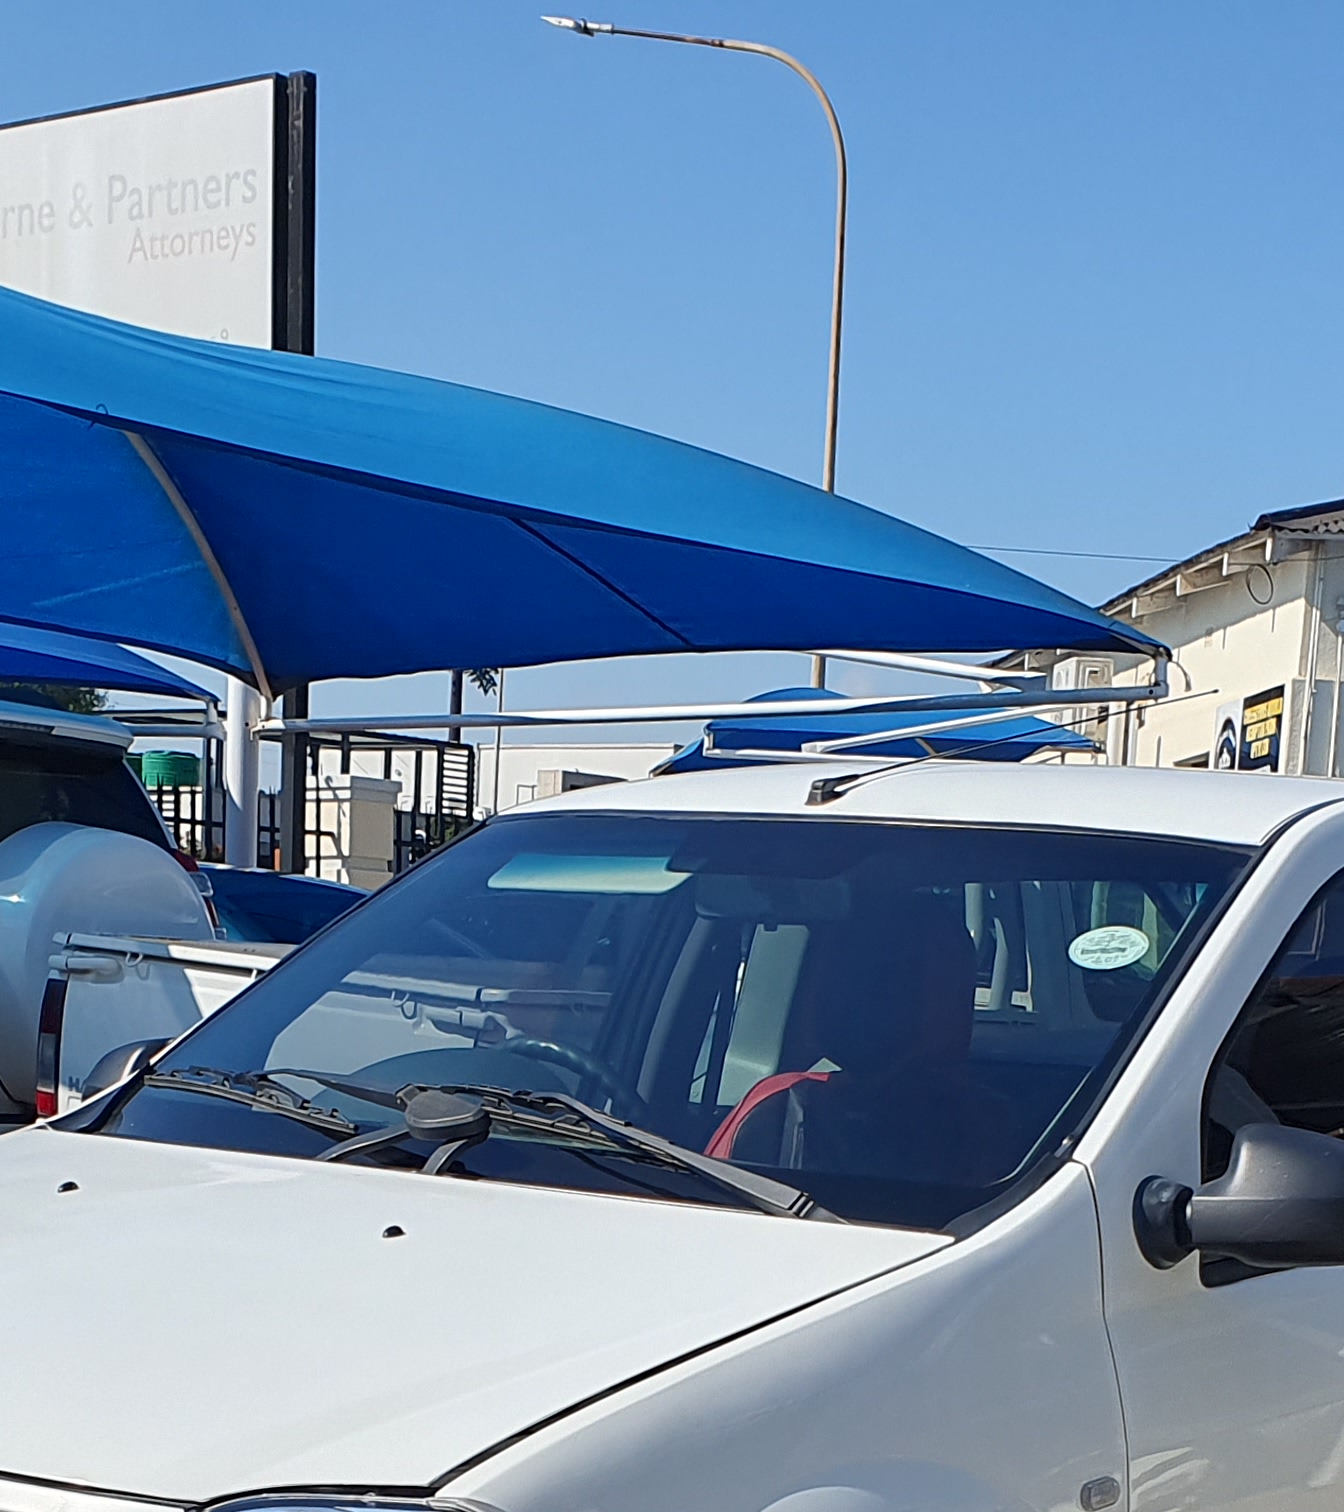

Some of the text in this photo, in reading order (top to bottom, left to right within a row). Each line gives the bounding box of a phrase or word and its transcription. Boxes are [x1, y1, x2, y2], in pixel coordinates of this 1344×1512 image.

[68, 181, 94, 230] &
[107, 168, 257, 225] Partners
[127, 222, 256, 264] Attorneys
